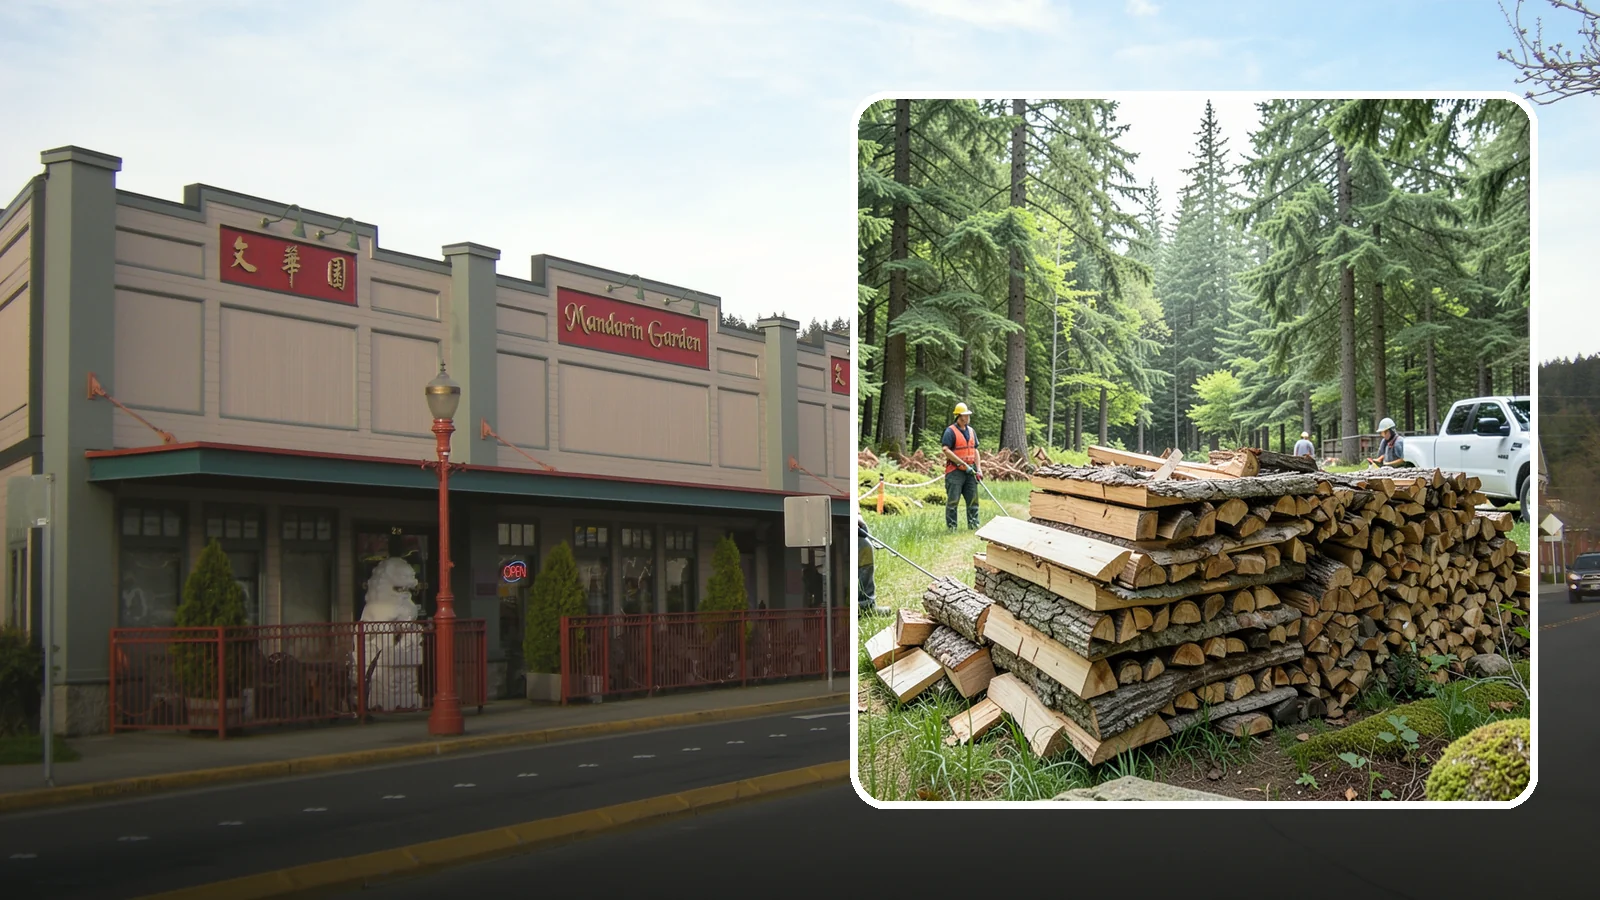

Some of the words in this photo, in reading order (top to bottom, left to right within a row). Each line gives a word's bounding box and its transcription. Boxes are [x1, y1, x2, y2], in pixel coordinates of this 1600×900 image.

[231, 236, 346, 291] 文華園
[564, 302, 643, 340] Mandarin
[648, 320, 701, 351] Garden
[503, 565, 527, 578] OPEN
